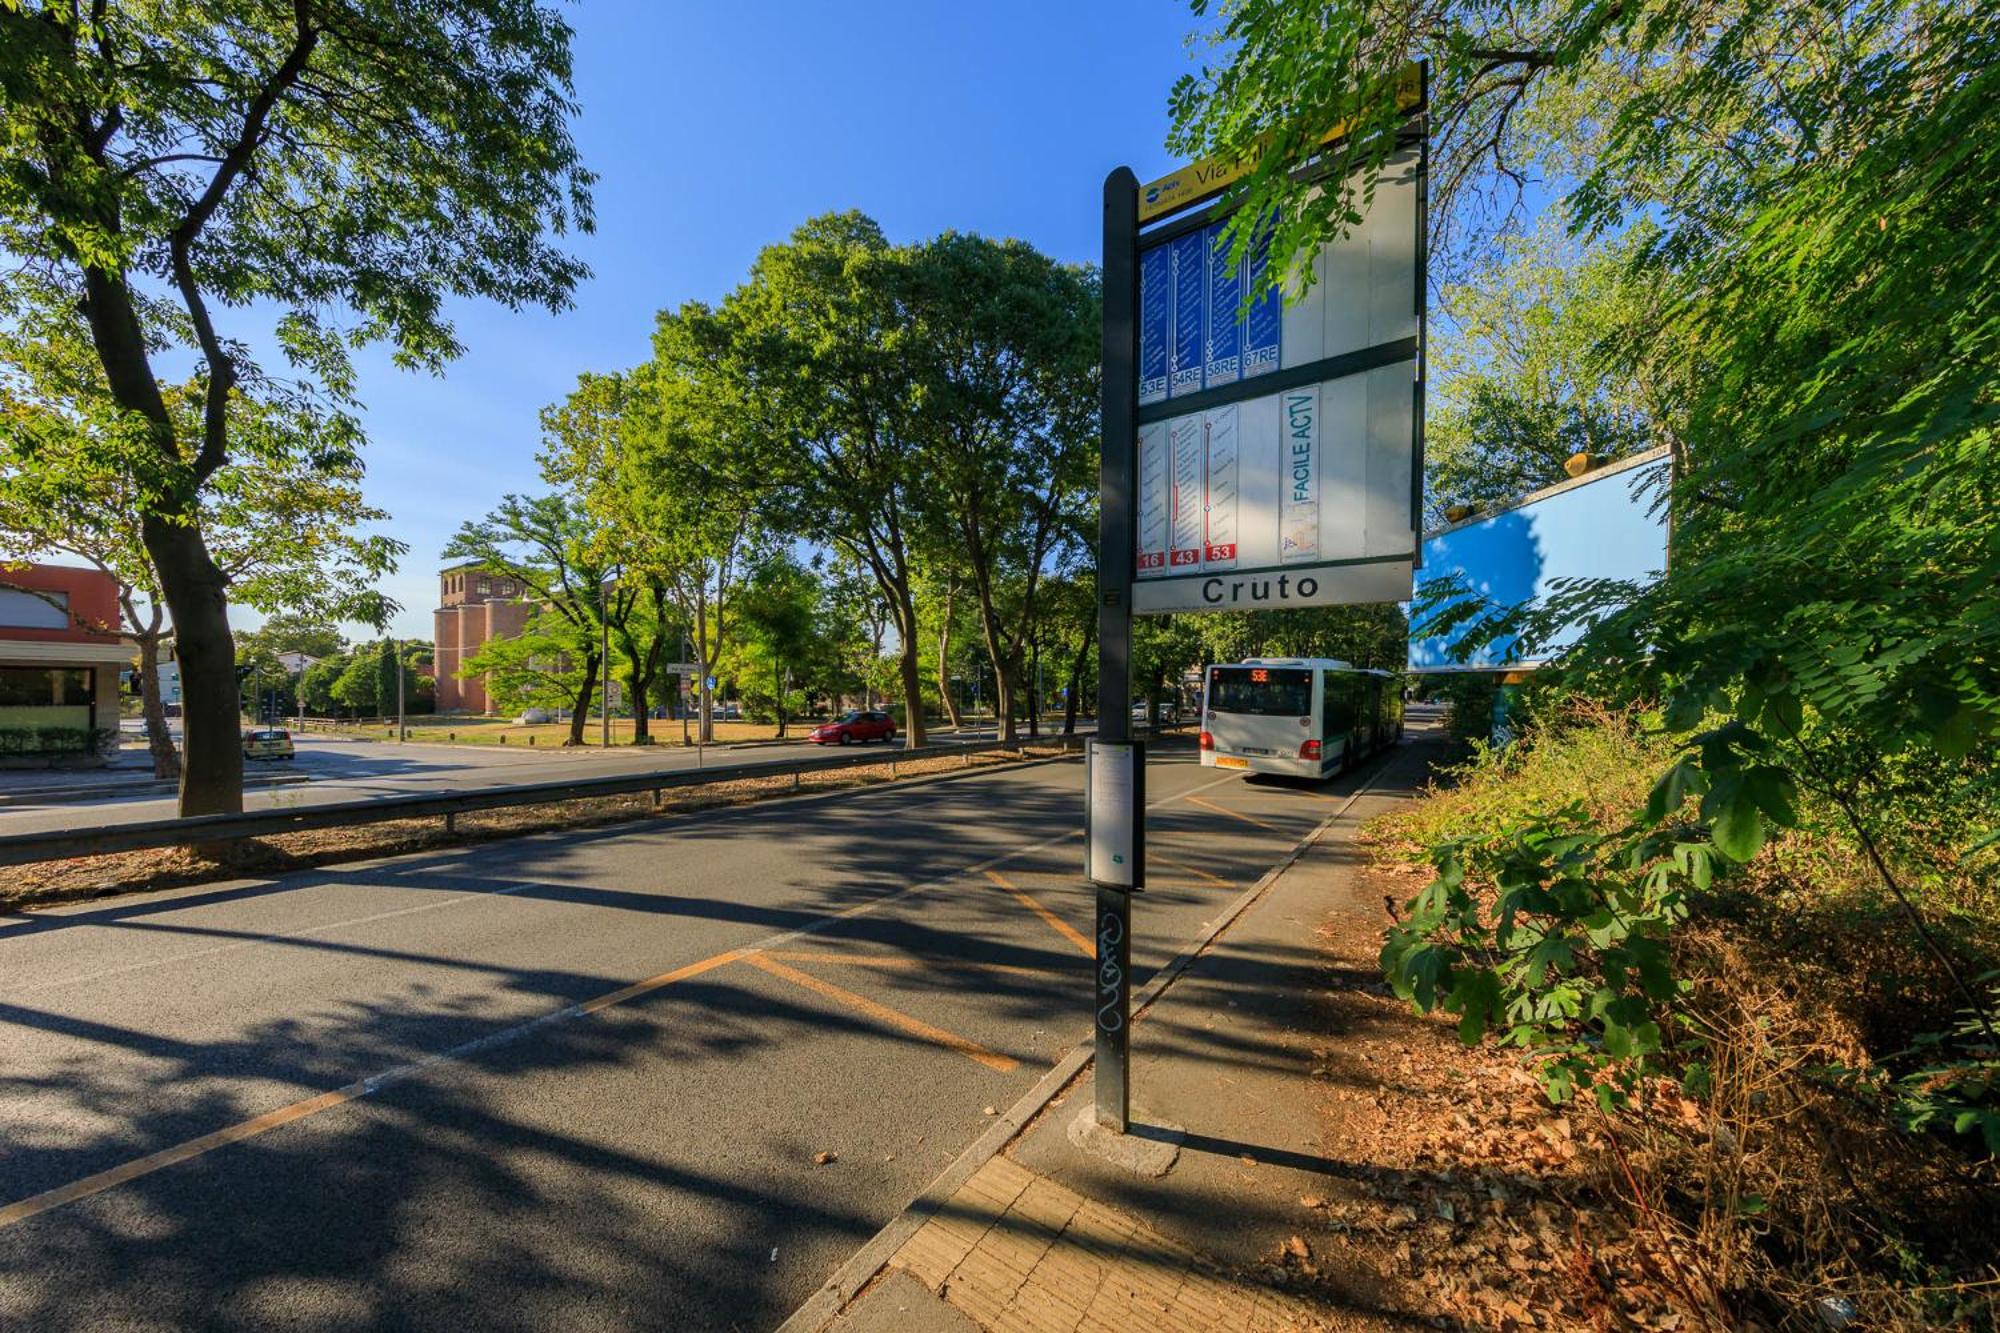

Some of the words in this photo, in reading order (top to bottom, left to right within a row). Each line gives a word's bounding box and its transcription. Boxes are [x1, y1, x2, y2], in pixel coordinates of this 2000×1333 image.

[1196, 162, 1227, 185] Via
[1244, 345, 1278, 367] 67RE
[1172, 367, 1200, 387] 54RE
[1207, 358, 1238, 377] 58RE
[1140, 378, 1165, 396] 53E
[1288, 396, 1313, 438] ACTV
[1293, 443, 1311, 501] FACILE
[1143, 554, 1160, 566] 16
[1175, 551, 1194, 564] 43
[1211, 545, 1230, 560] 53
[1202, 575, 1319, 603] Cruto
